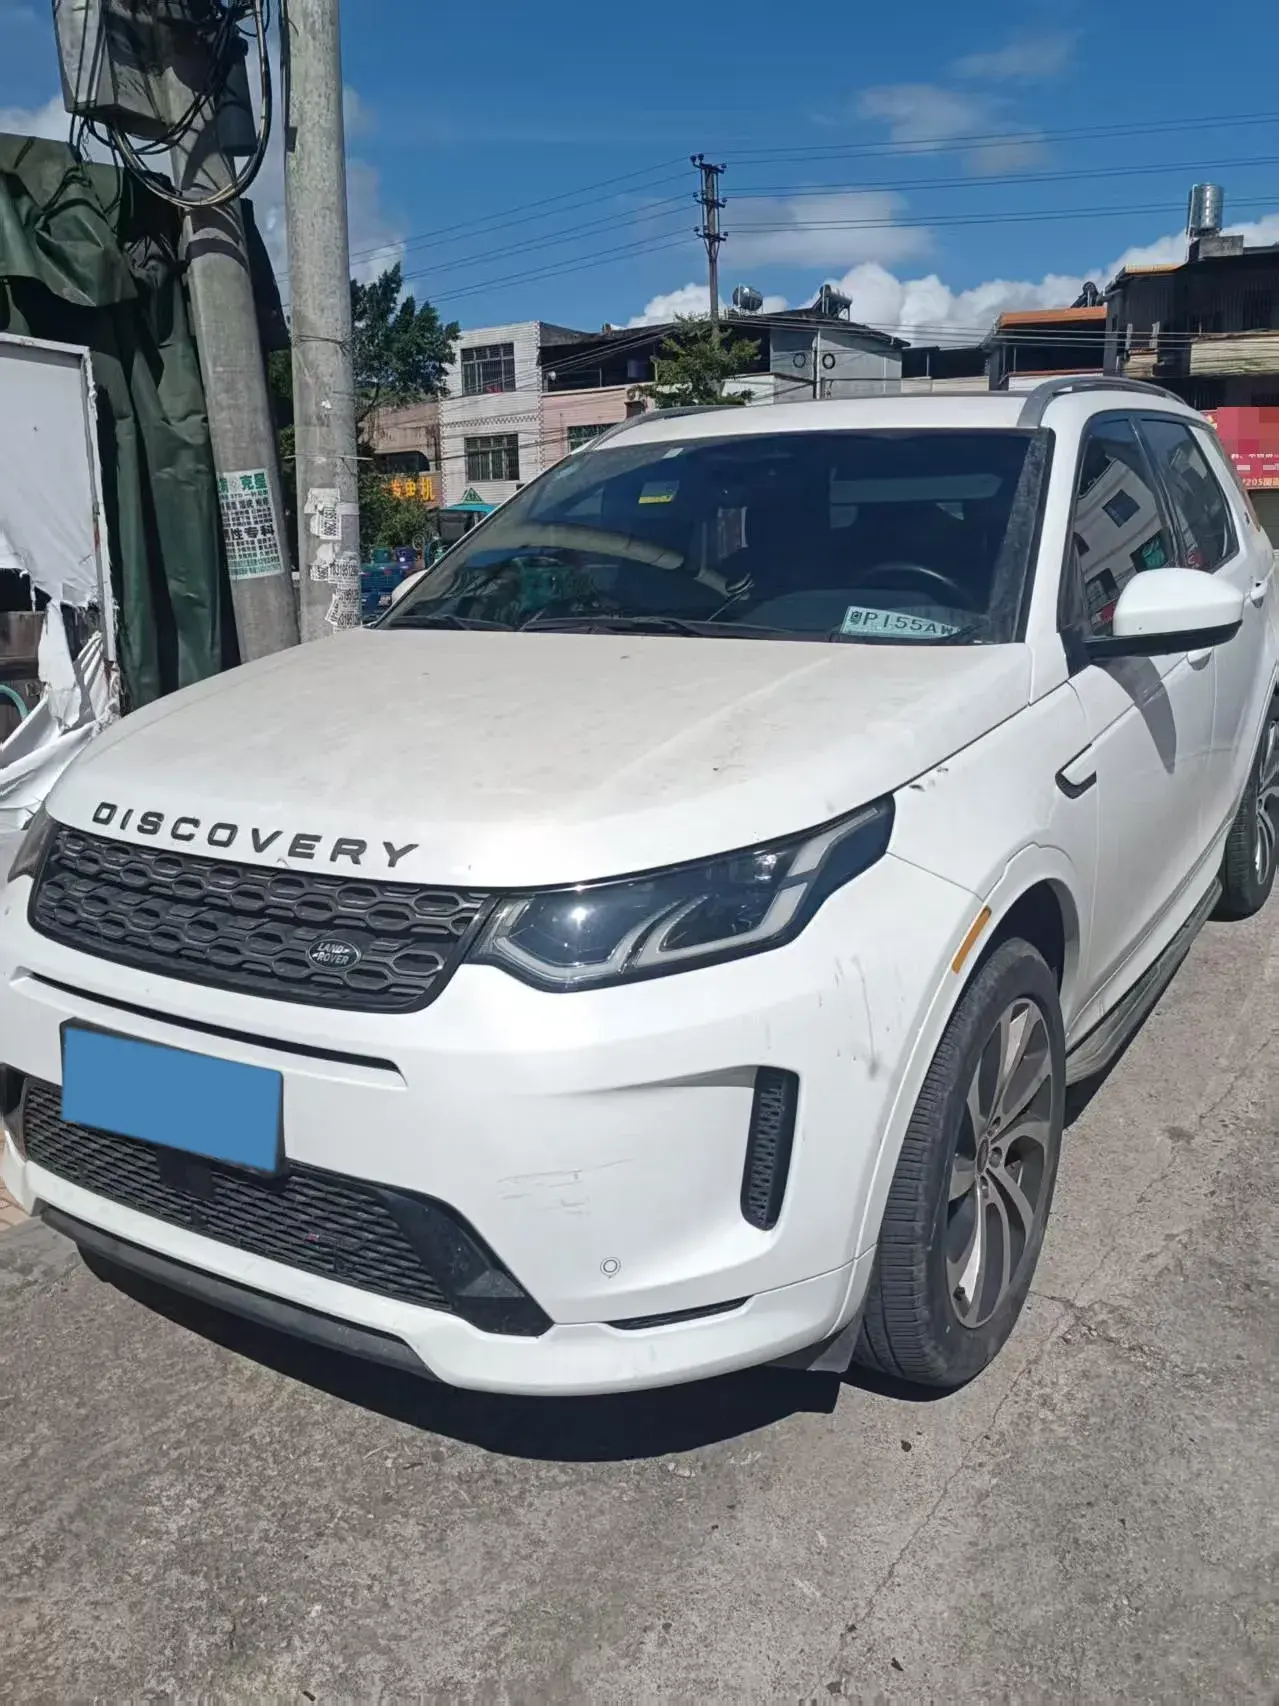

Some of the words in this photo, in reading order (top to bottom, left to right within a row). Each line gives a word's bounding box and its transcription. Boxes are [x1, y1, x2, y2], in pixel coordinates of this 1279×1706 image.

[92, 801, 420, 868] DISCOVERY
[316, 942, 344, 954] LAND
[316, 951, 349, 965] ROVER
